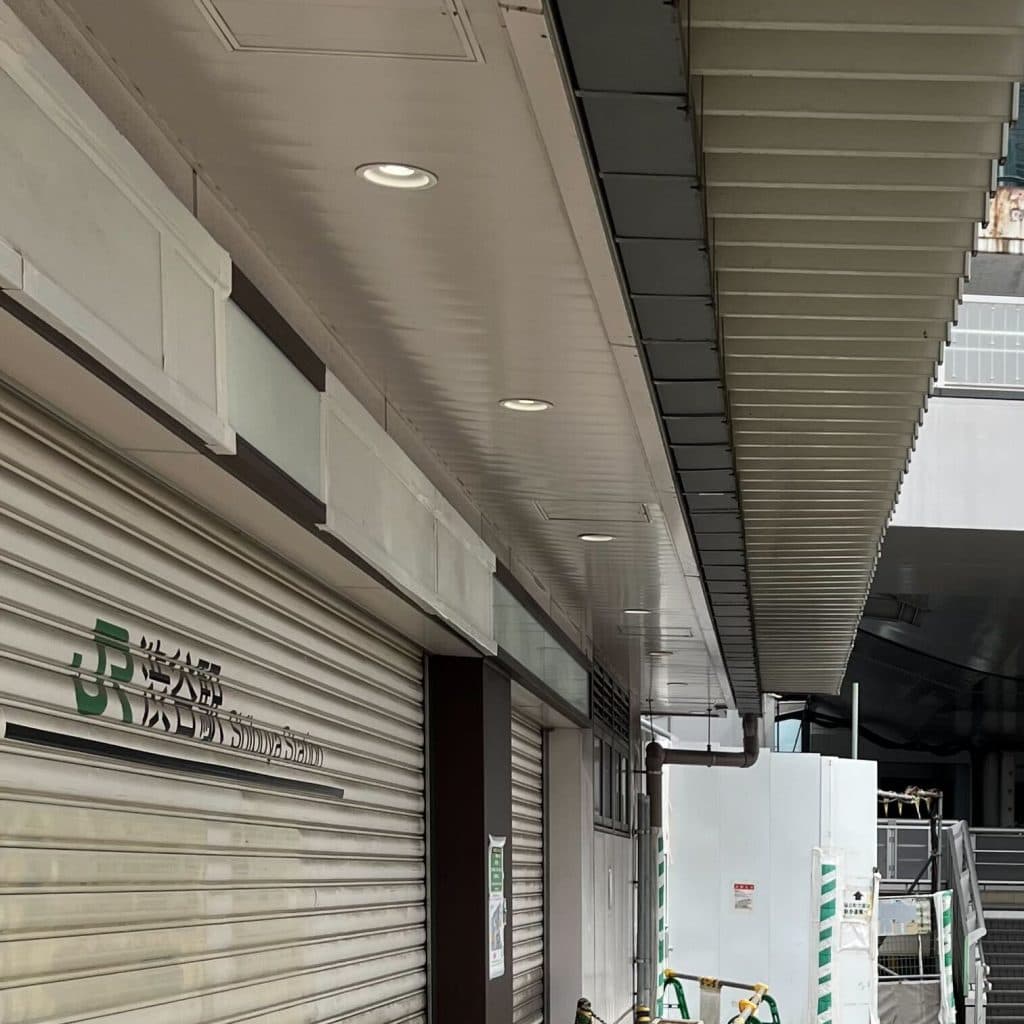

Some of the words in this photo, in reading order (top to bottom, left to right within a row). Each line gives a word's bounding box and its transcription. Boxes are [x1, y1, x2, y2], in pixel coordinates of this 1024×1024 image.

[71, 617, 134, 725] JR
[140, 635, 224, 745] 渋谷駅
[229, 709, 281, 764] Shibuya
[281, 725, 324, 768] Station
